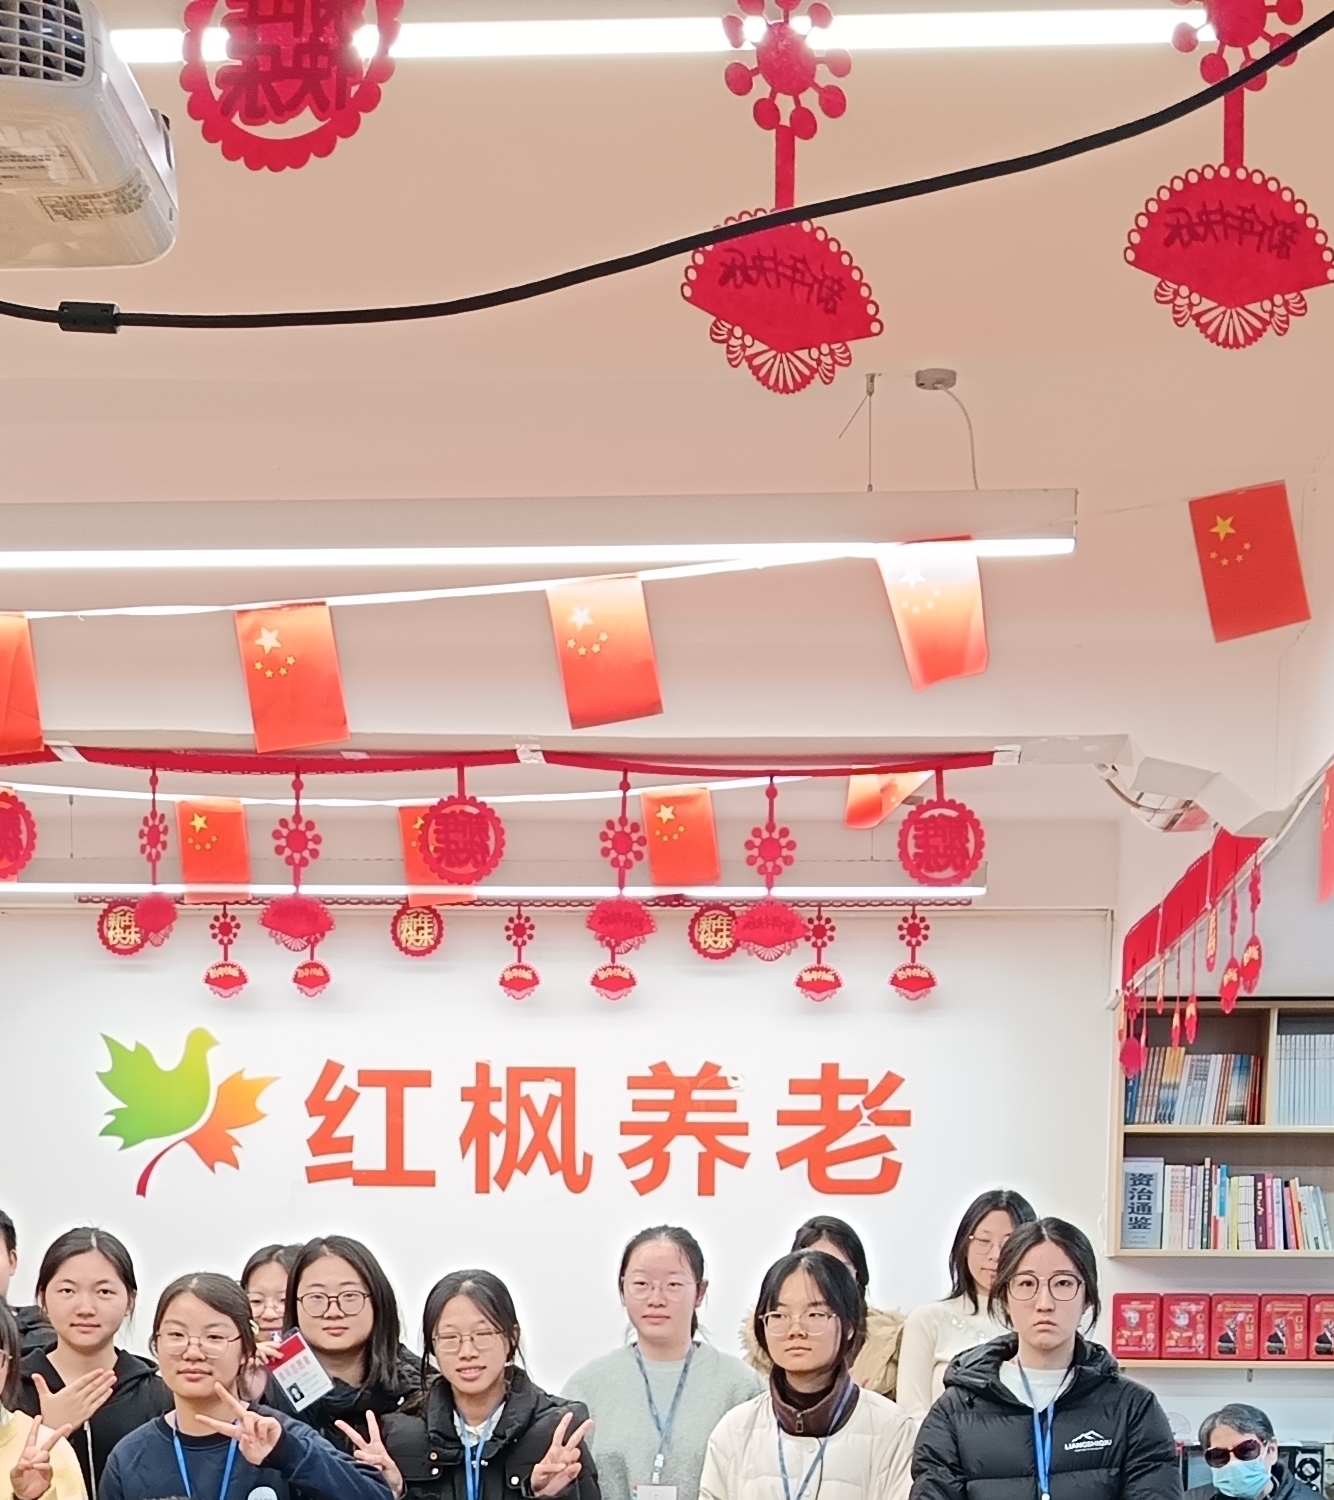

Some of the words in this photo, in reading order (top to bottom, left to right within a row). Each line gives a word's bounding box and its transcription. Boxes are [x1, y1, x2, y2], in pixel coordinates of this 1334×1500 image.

[304, 1059, 911, 1196] 红枫养老
[1128, 1172, 1154, 1230] 资治通鉴
